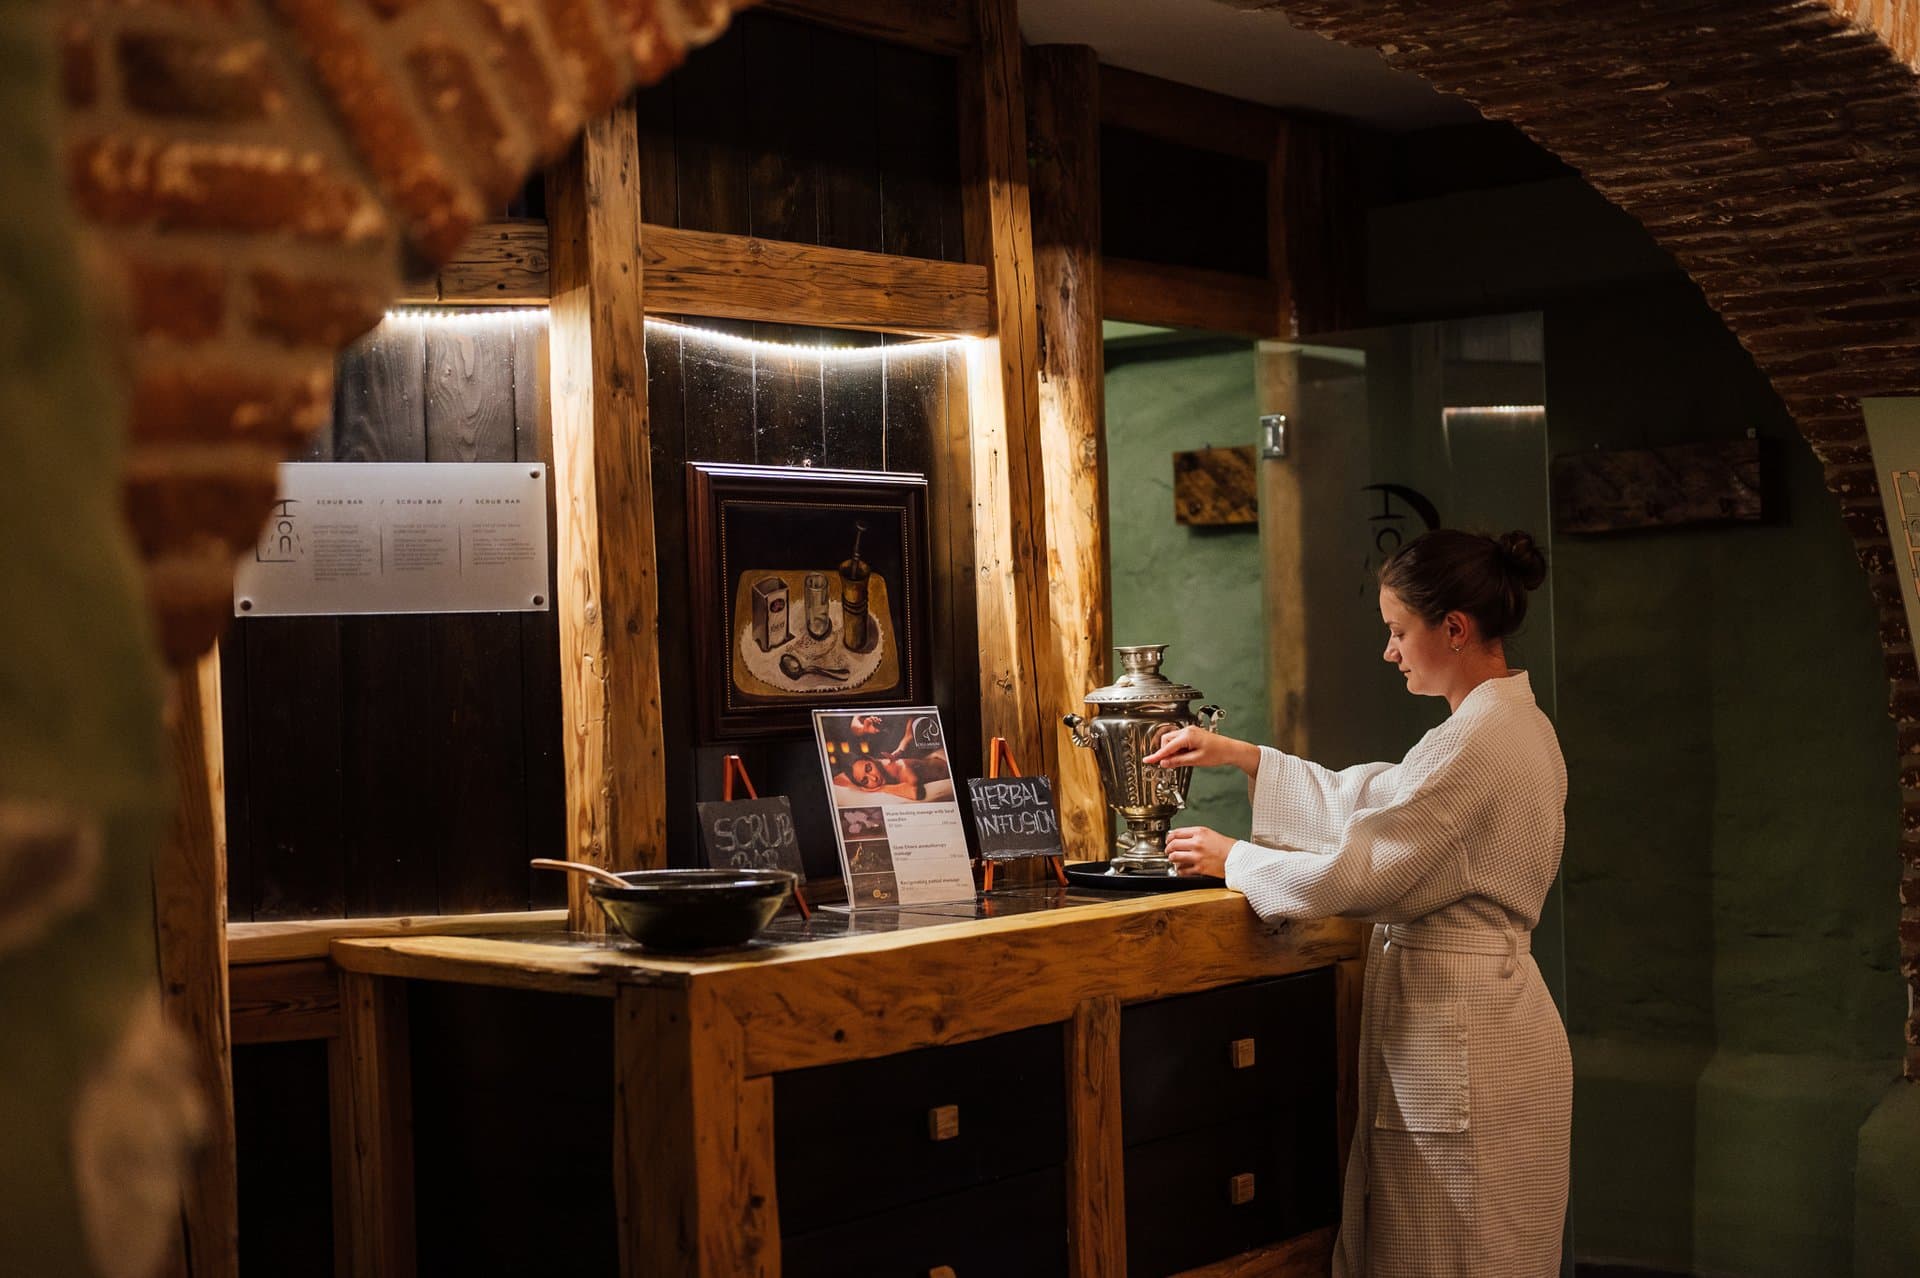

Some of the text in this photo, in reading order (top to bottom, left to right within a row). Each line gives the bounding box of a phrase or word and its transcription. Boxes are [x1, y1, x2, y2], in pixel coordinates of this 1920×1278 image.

[971, 783, 1049, 812] HERBAL
[714, 812, 794, 851] SCRUB
[975, 809, 1058, 840] INFUSION
